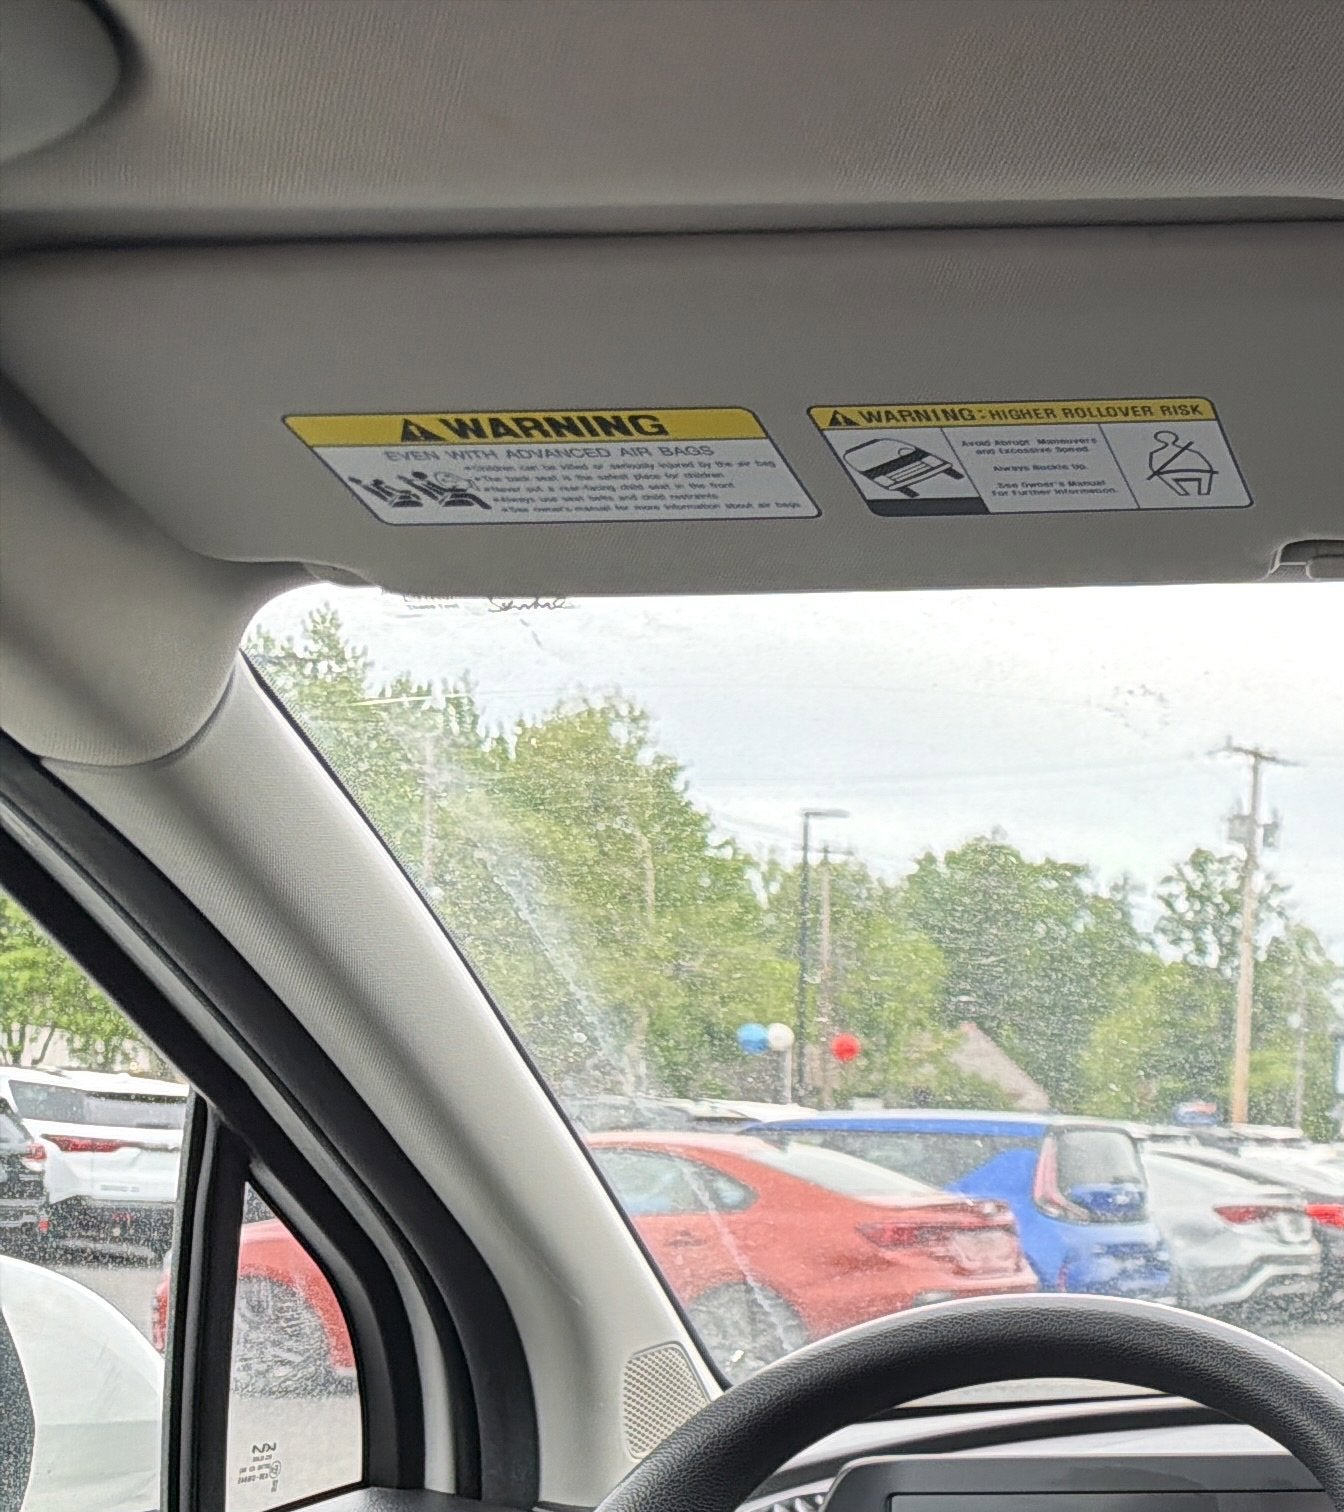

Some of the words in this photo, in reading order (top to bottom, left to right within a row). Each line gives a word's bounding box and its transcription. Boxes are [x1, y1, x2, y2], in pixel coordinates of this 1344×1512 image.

[989, 407, 1055, 421] HIGHER
[1062, 405, 1156, 420] ROLLOVER
[1161, 403, 1203, 418] RISK
[439, 414, 669, 440] WARNING
[384, 449, 440, 462] EVEN
[444, 448, 498, 461] WITH
[506, 447, 611, 460] ADVANCED
[620, 446, 652, 458] AIR
[658, 445, 715, 456] BAGS
